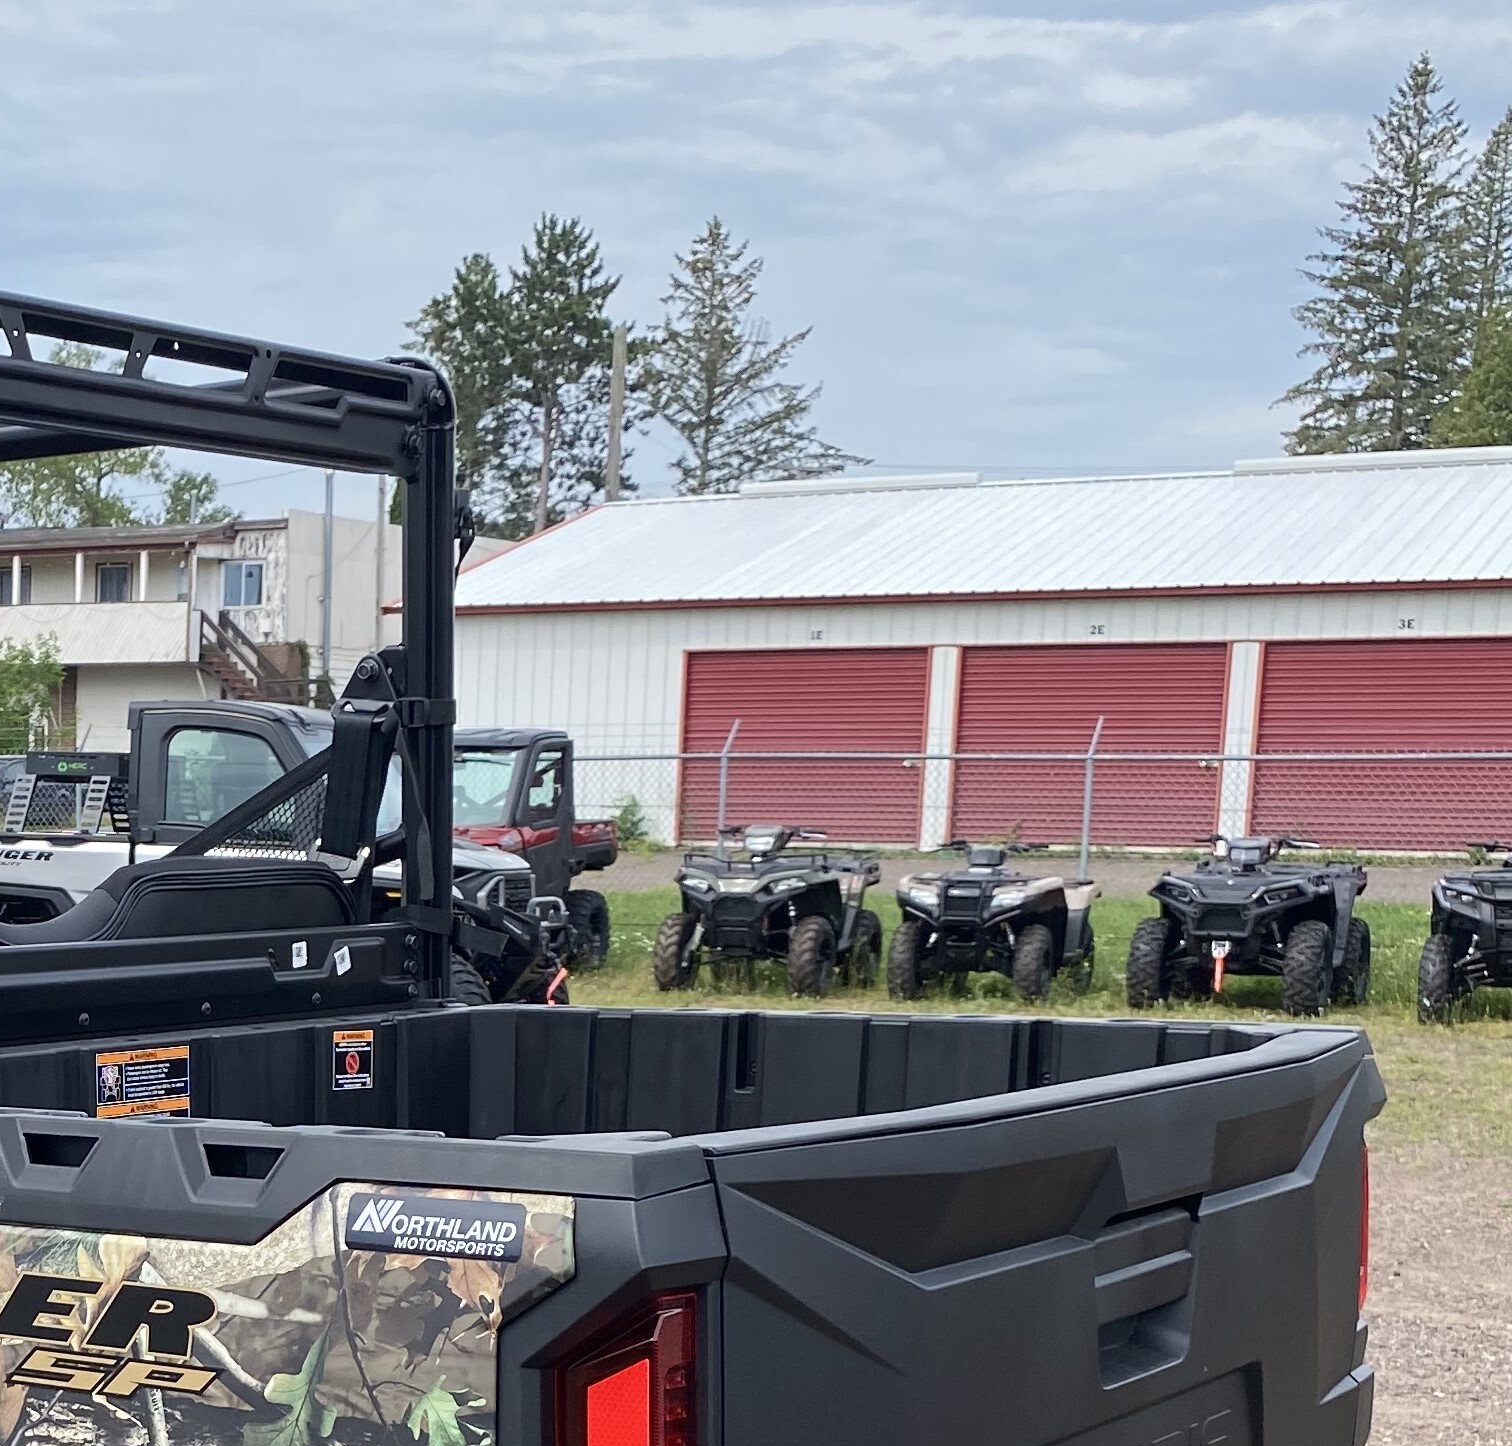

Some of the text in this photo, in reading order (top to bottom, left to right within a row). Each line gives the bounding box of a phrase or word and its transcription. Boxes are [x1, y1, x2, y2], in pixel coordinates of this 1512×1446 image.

[1088, 625, 1105, 636] 2E
[1397, 618, 1415, 630] 3E
[810, 630, 823, 641] 1E
[351, 1198, 518, 1243] NORTHLAND
[393, 1236, 506, 1258] MOTORSPORTS
[4, 1345, 226, 1398] SP
